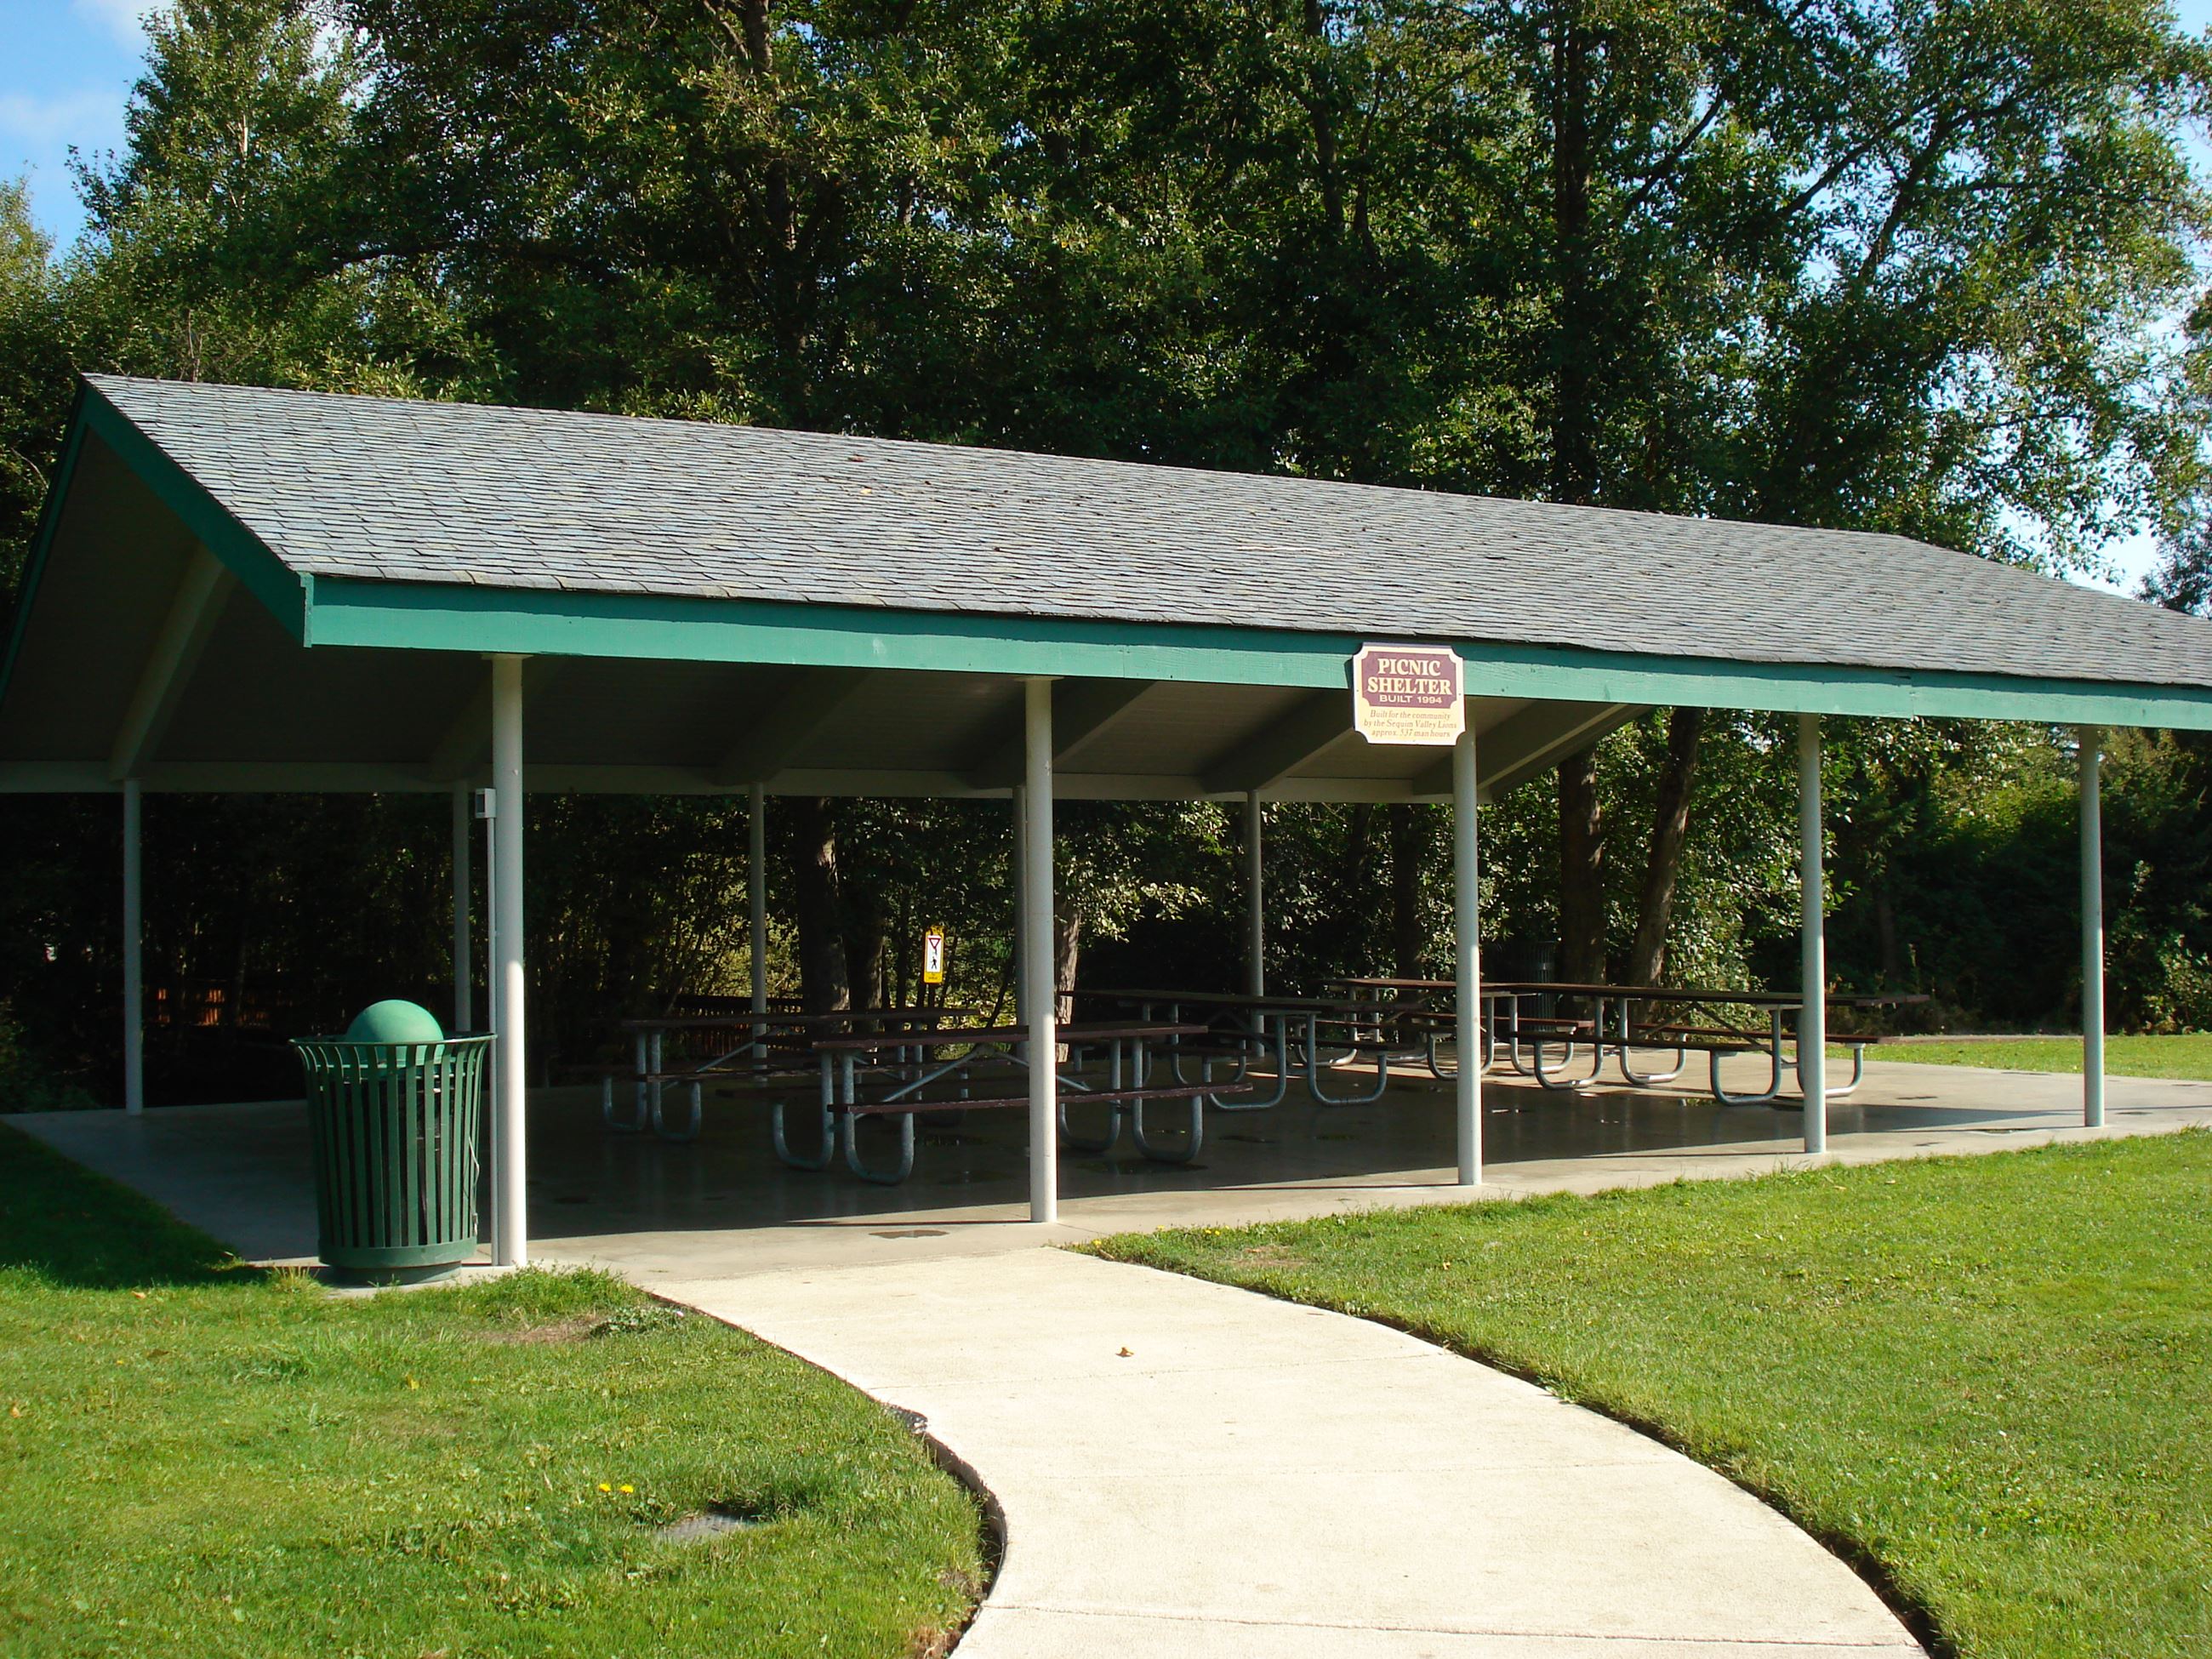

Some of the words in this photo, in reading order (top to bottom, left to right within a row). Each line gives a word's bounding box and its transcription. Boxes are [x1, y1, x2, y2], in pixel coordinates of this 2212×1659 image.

[1377, 658, 1441, 676] PICNIC
[1367, 677, 1452, 695] SHELTER
[1380, 694, 1412, 703] BUILT
[1370, 710, 1388, 718] Built
[1388, 710, 1399, 719] for
[1412, 711, 1451, 720] community
[1364, 719, 1372, 728] by
[1387, 720, 1413, 729] Sequim
[1415, 721, 1436, 729] Valley
